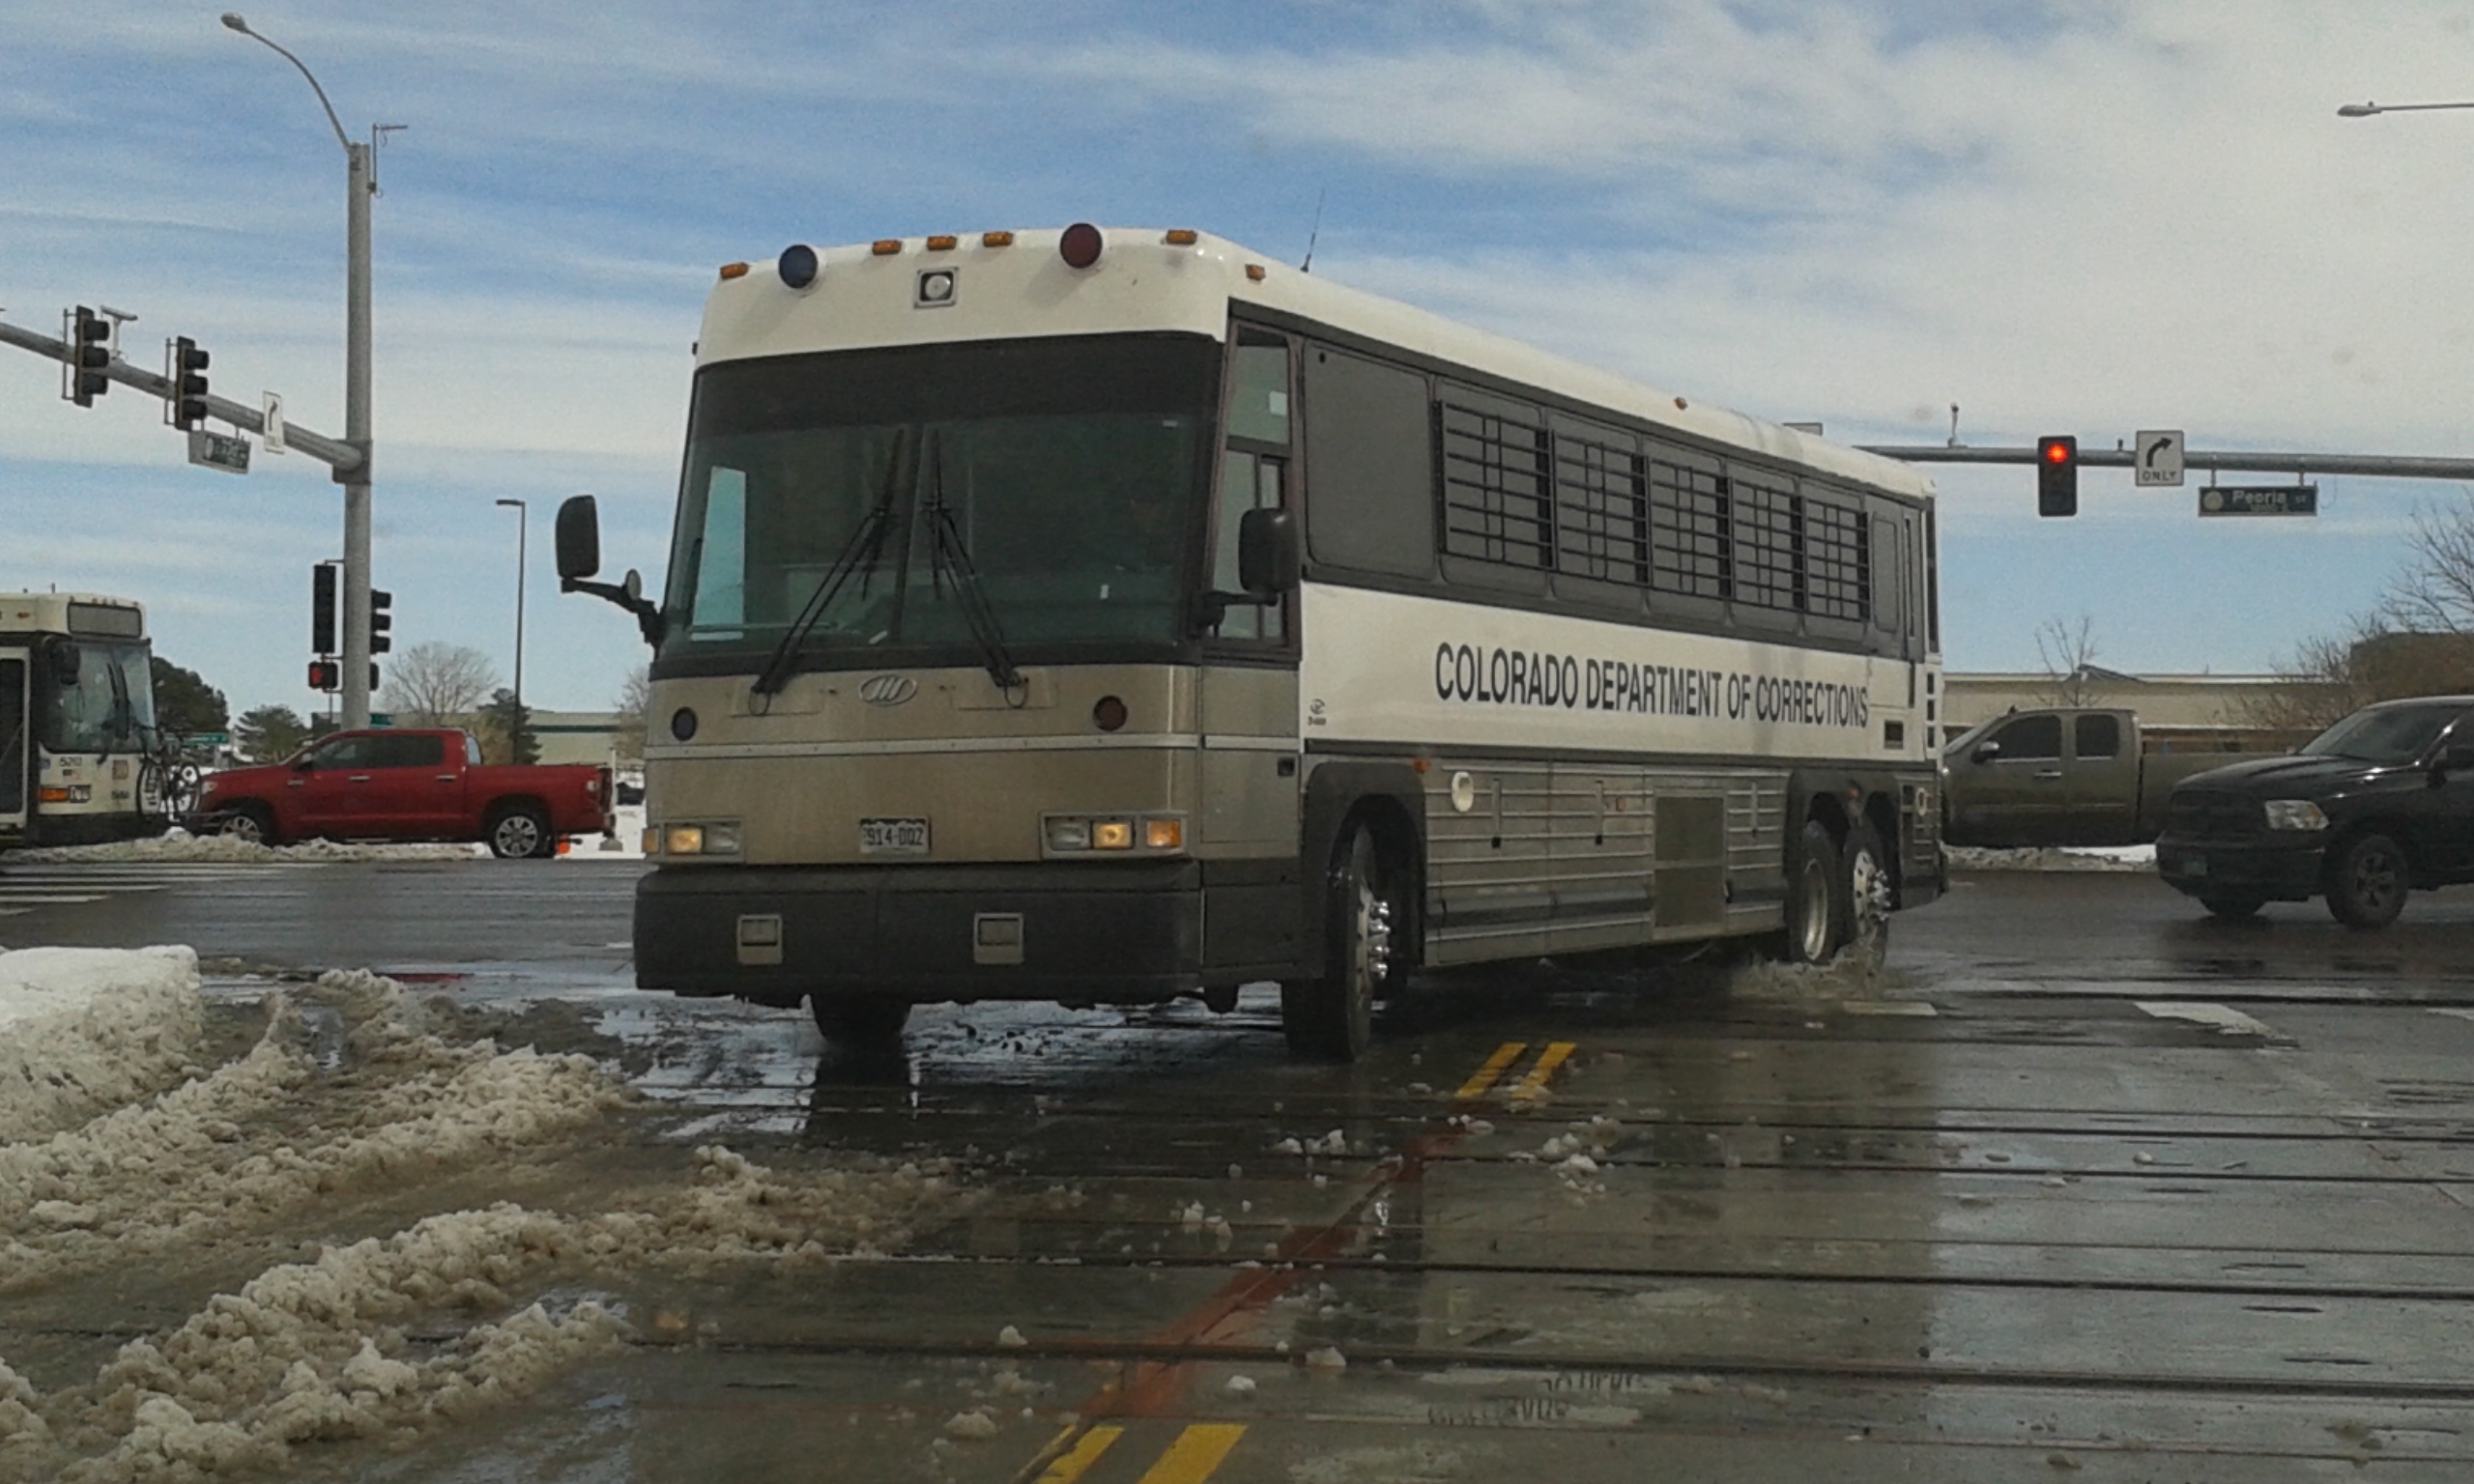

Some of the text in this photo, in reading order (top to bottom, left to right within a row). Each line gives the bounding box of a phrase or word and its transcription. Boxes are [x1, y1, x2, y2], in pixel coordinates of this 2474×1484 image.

[2142, 471, 2177, 481] ONLY
[2232, 490, 2287, 504] Peoria
[1435, 642, 1869, 728] COLORADO DEPARTMENT OF CORRECTIONS
